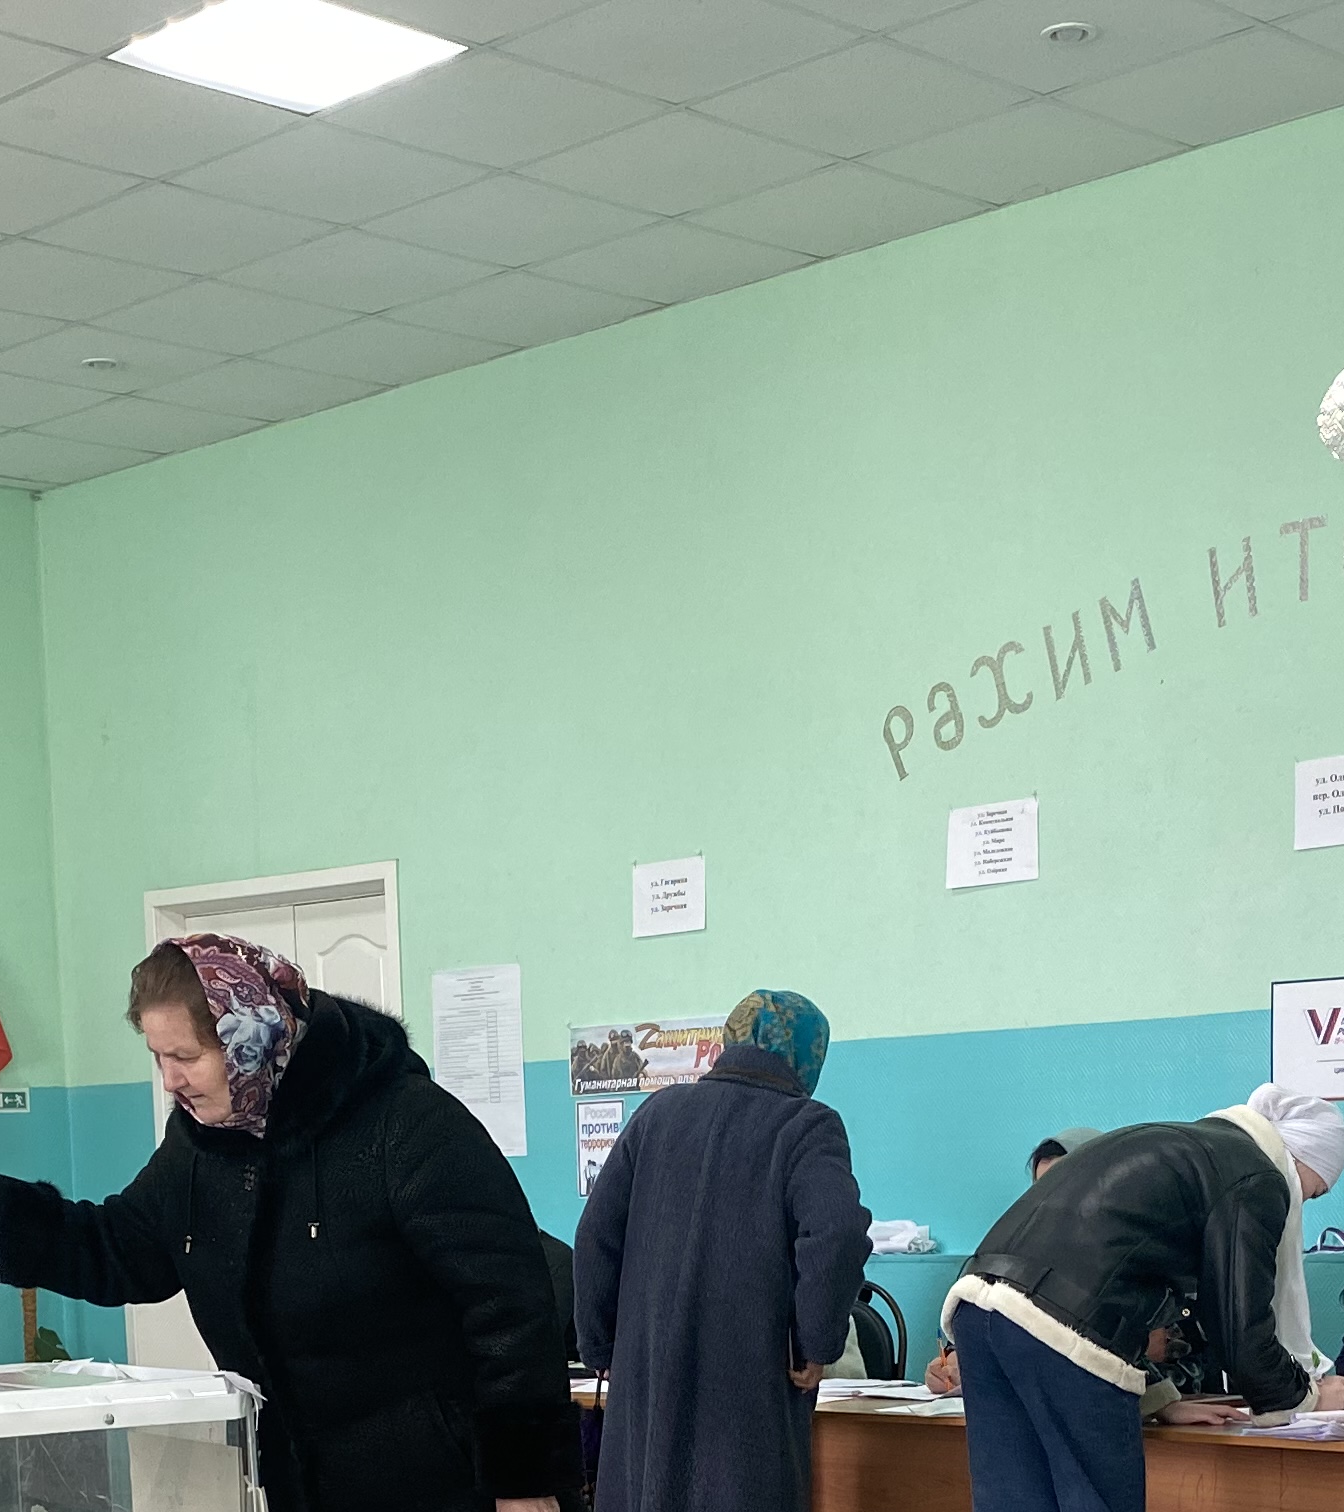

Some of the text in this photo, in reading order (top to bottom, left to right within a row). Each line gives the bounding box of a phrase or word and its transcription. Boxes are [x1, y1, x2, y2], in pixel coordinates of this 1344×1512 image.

[1315, 776, 1328, 787] ул.
[1318, 808, 1331, 818] ул.
[574, 1077, 637, 1094] Гуманитарная
[639, 1074, 674, 1088] помощь
[677, 1074, 694, 1084] для
[584, 1106, 617, 1119] Россия
[581, 1121, 619, 1137] против
